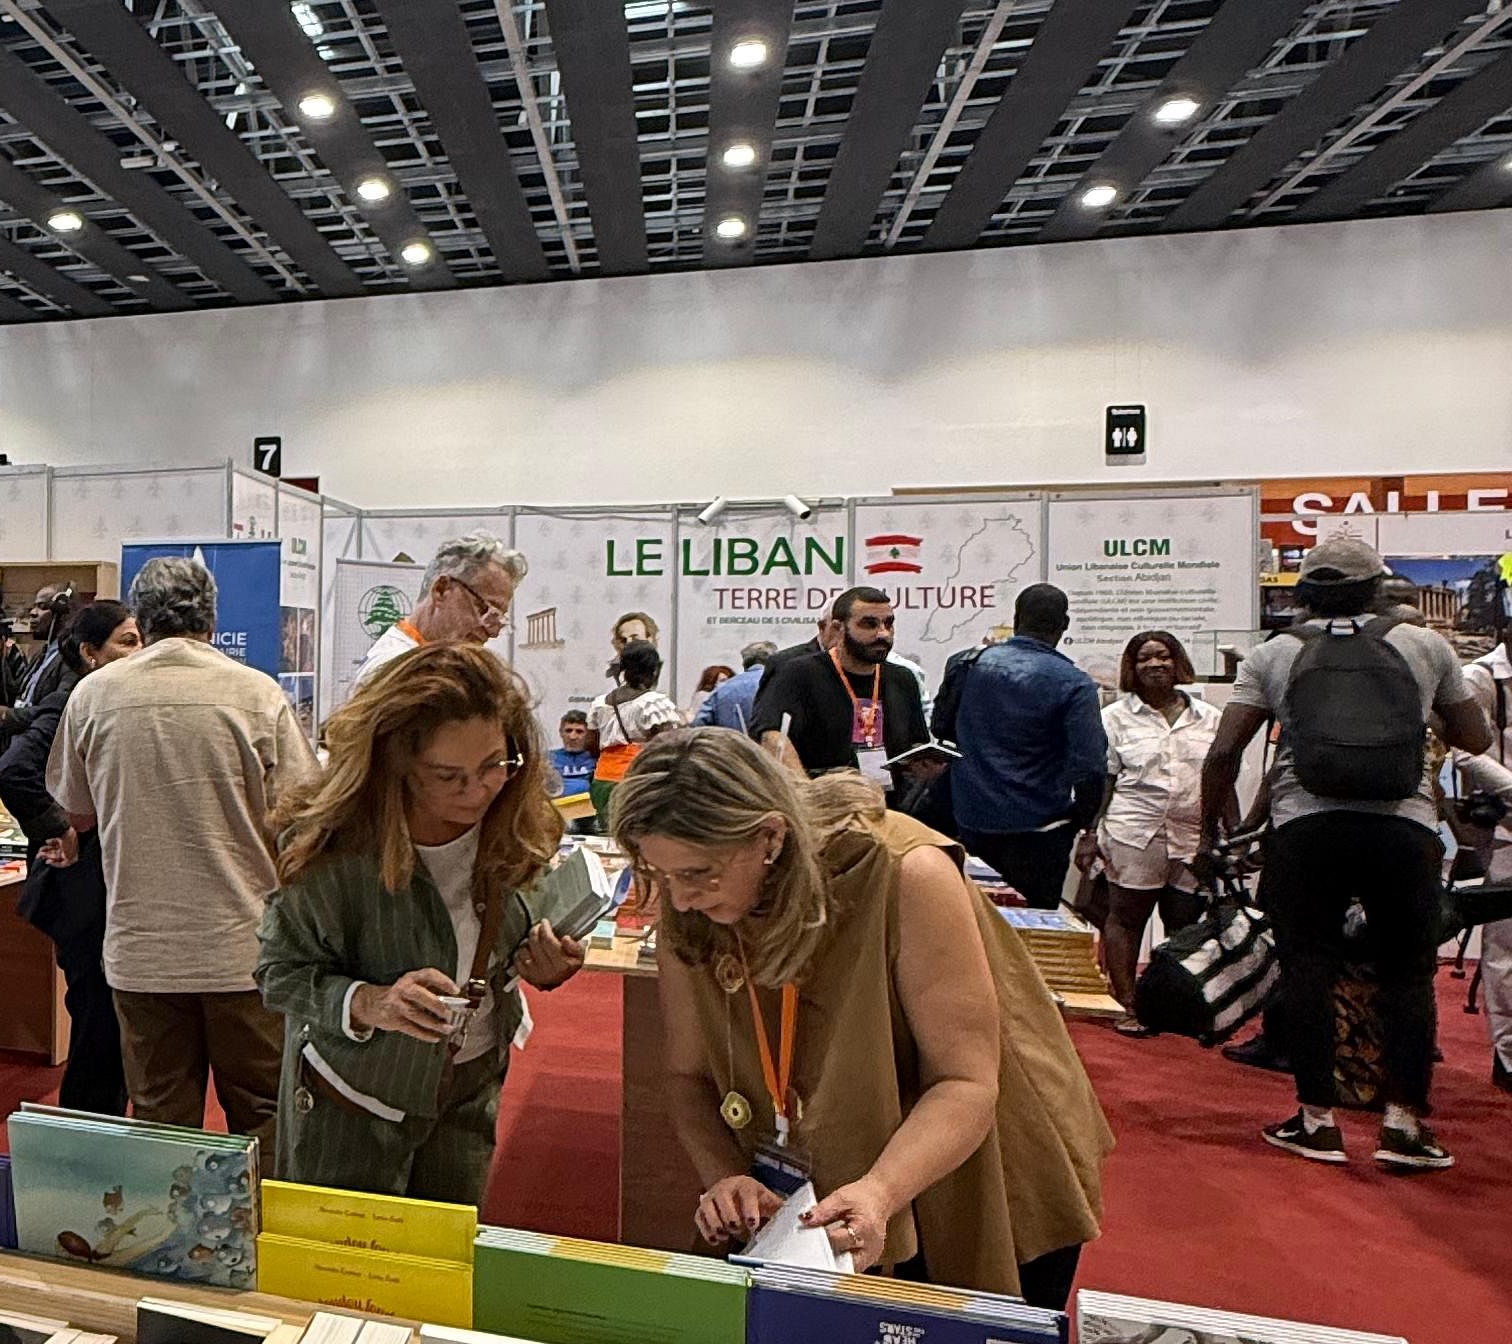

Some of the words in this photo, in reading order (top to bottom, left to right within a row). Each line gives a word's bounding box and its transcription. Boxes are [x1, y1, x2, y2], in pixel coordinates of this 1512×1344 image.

[259, 444, 277, 470] 7
[606, 538, 663, 576] LE
[682, 536, 844, 576] LIBAN
[1104, 539, 1171, 557] ULCM
[1056, 562, 1082, 571] Union
[1085, 561, 1129, 571] Libanaise
[1131, 561, 1175, 570] Culturelle
[1177, 560, 1220, 569] Mondiale
[1096, 574, 1133, 583] Section
[1135, 573, 1171, 583] Abidjan
[712, 588, 797, 609] TERRE
[887, 585, 995, 610] ULTURE
